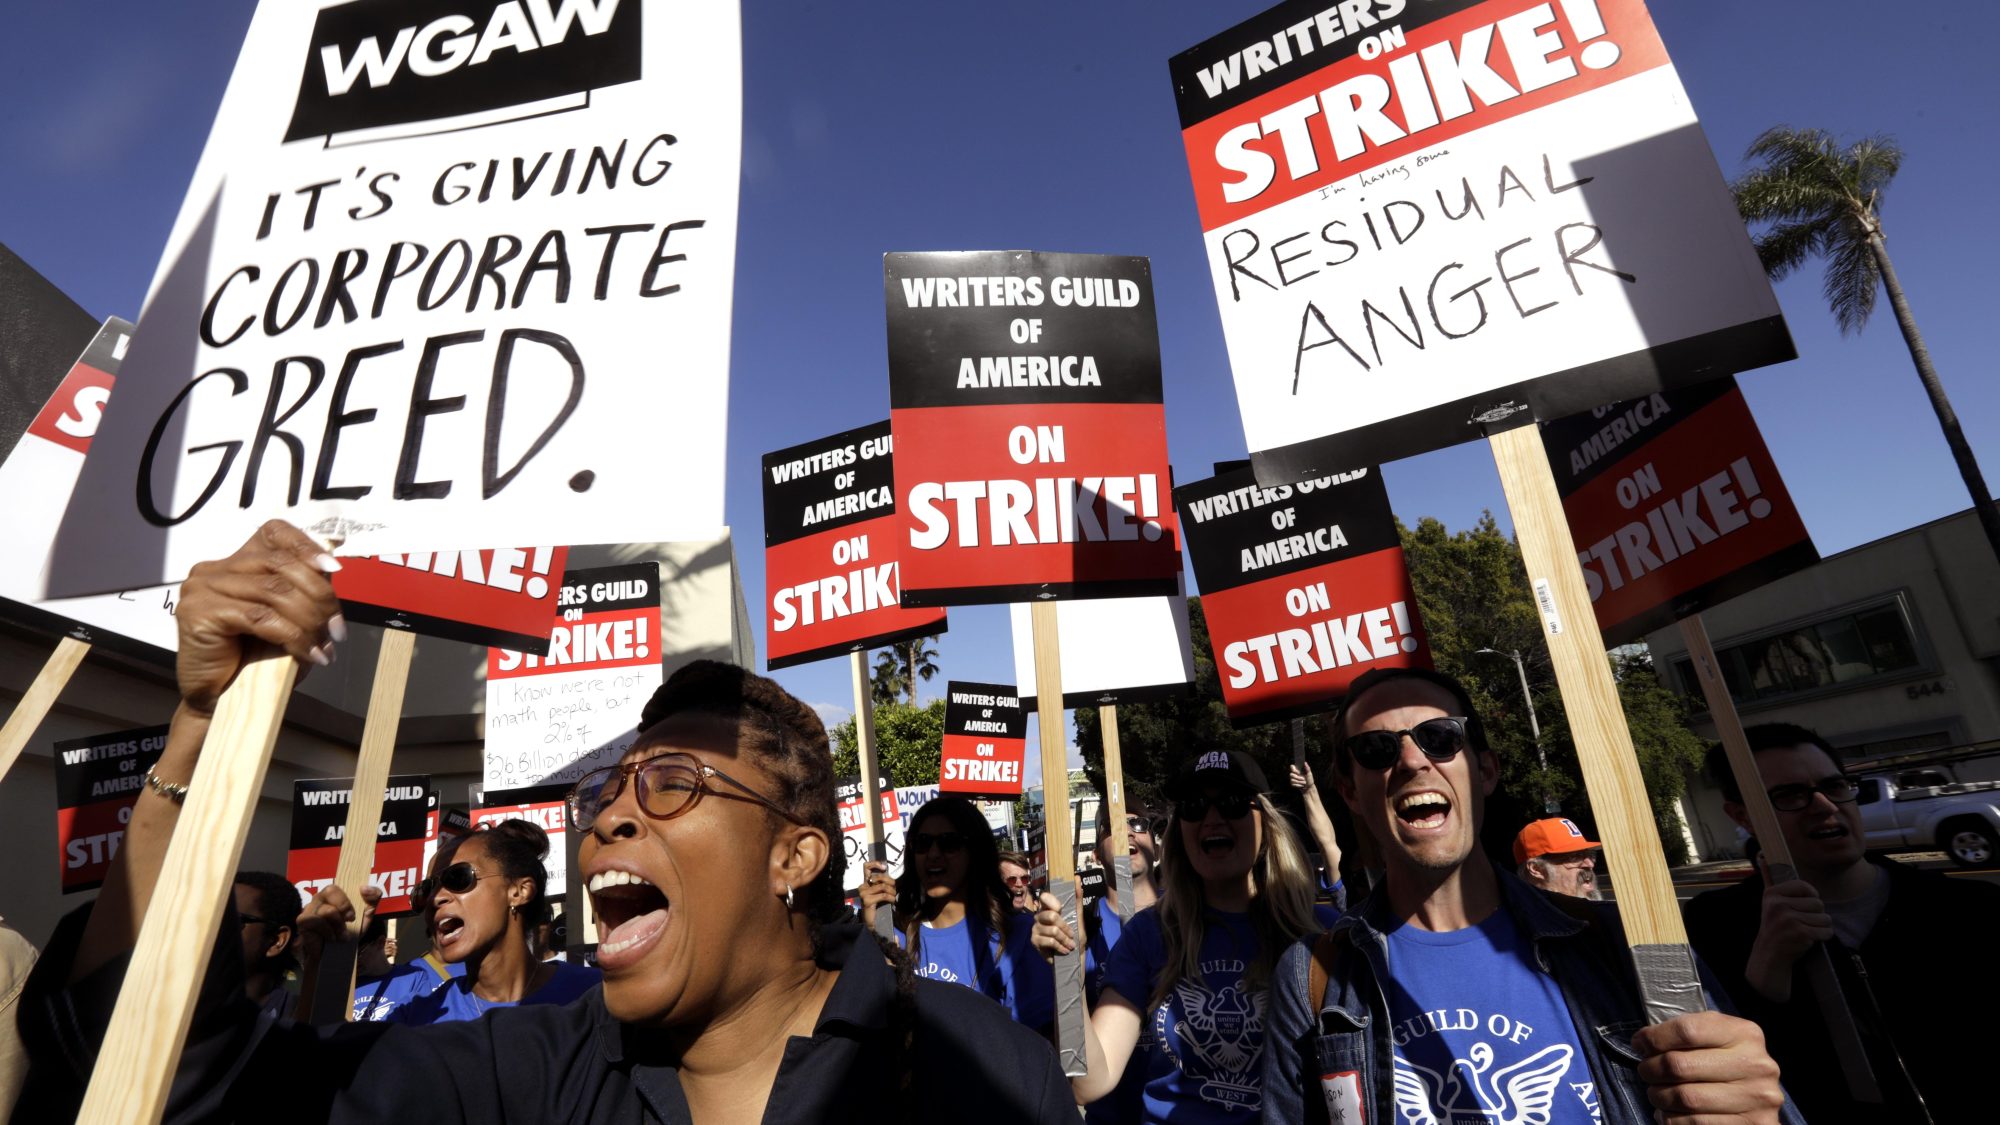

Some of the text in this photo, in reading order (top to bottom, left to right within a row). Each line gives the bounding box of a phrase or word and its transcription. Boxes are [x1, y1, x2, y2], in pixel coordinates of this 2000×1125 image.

[320, 0, 620, 97] WGAW
[1196, 0, 1406, 99] WRITERS
[1357, 25, 1407, 61] ON
[1214, 0, 1622, 204] STRIKE!
[256, 134, 679, 241] IT'S GIVING
[200, 219, 706, 349] CORPORATE
[901, 276, 1140, 308] WRITERS GUILD
[1292, 221, 1637, 396] ANGER
[1010, 318, 1042, 344] OF
[956, 356, 1101, 389] AMERICA
[135, 328, 597, 527] GREED.
[1569, 392, 1672, 476] AMERICA
[1008, 425, 1065, 465] ON
[771, 445, 857, 485] WRITERS
[834, 470, 856, 491] OF
[1616, 462, 1662, 510] ON
[802, 485, 893, 527] AMERICA
[908, 473, 1162, 550] STRIKE!
[1271, 507, 1296, 531] OF
[1576, 456, 1772, 602] STRIKE!
[832, 534, 869, 566] ON
[1240, 524, 1349, 573] AMERICA
[591, 579, 649, 601] GUILD
[773, 561, 901, 632] STRIK
[1285, 581, 1331, 617] ON
[564, 608, 583, 622] ON
[1223, 600, 1418, 689] STRIKE!
[613, 671, 645, 689] not
[952, 693, 995, 707] WRITERS
[982, 709, 993, 719] OF
[964, 720, 1007, 734] AMERICA
[62, 739, 138, 766] WRITERS
[119, 759, 137, 773] OF
[976, 743, 993, 757] ON
[1198, 751, 1229, 765] WGA
[944, 758, 1019, 784] STRIKE!
[1194, 761, 1229, 773] CAPTAIN
[117, 806, 133, 824] O
[1083, 875, 1102, 886] GUILD
[1392, 1008, 1534, 1048] GUILD OF
[1215, 1088, 1248, 1103] WEST
